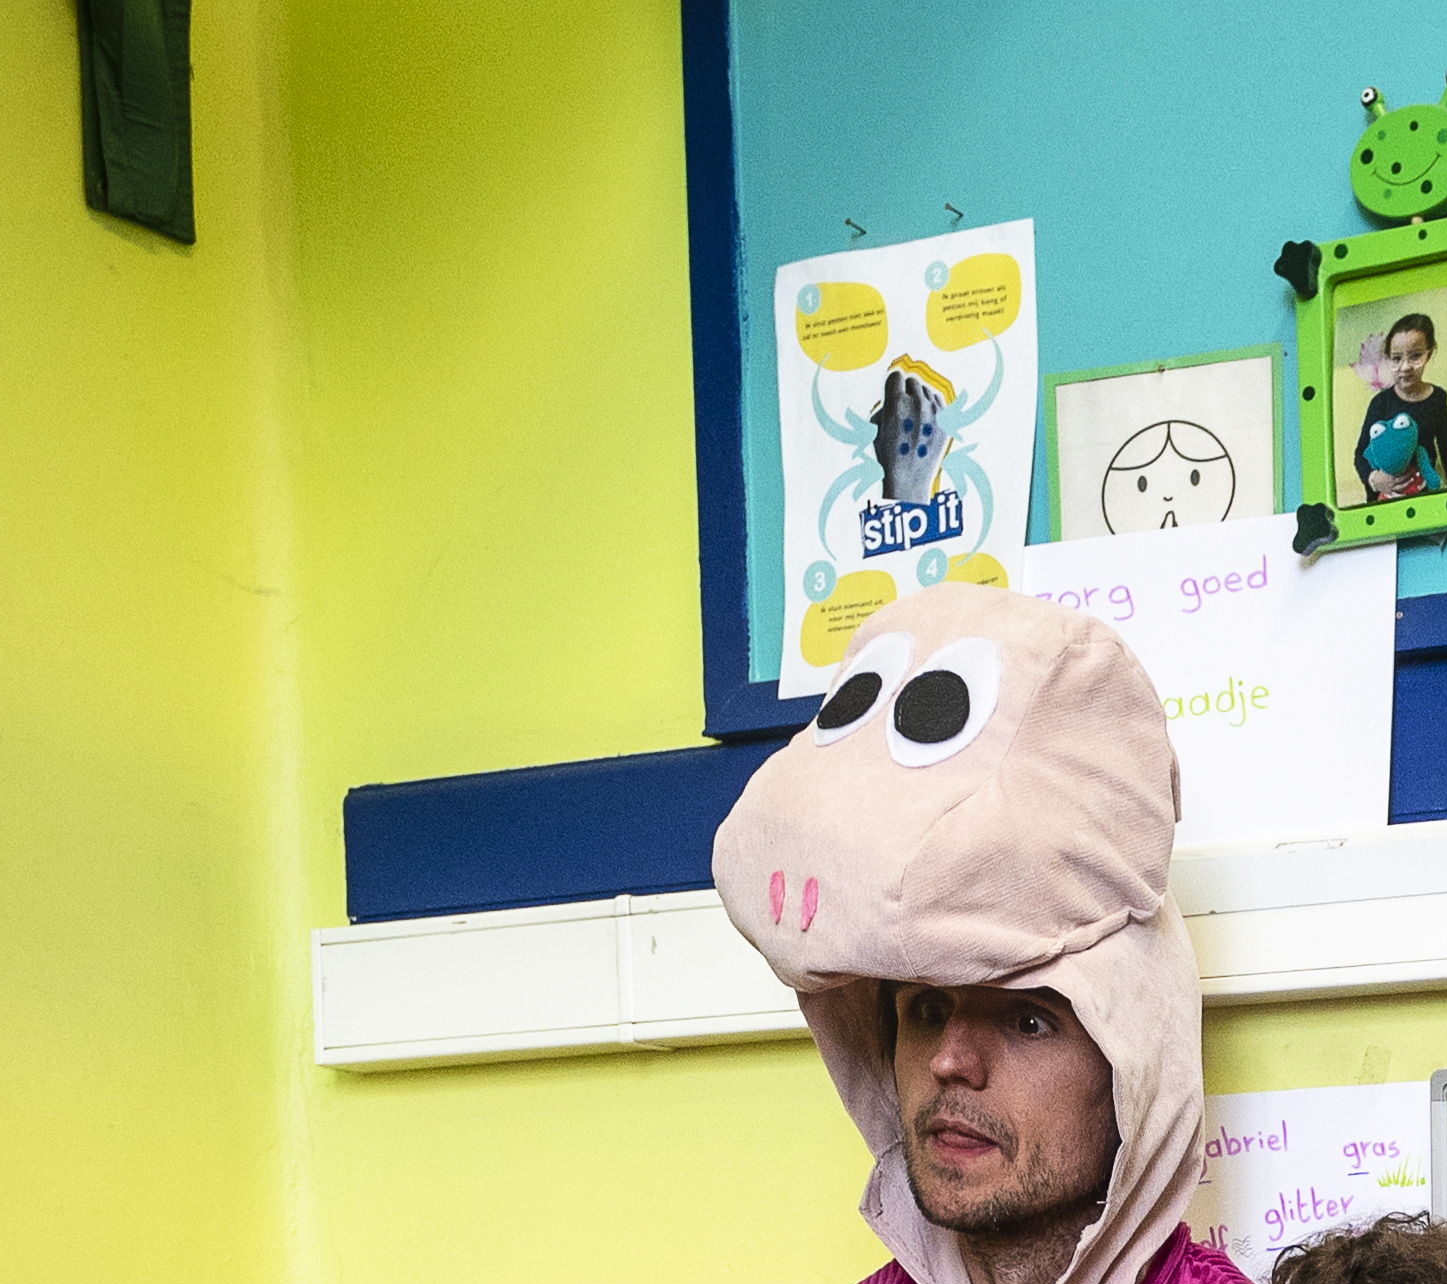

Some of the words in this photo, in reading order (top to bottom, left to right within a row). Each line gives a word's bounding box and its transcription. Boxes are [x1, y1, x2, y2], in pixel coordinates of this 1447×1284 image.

[931, 267, 942, 284] 2
[864, 504, 928, 551] stip
[937, 493, 961, 534] it
[812, 571, 826, 593] 3
[925, 557, 938, 578] 4
[1034, 584, 1136, 621] org
[1180, 553, 1270, 614] goed
[1162, 675, 1271, 728] aadje
[1204, 1118, 1289, 1159] abriel
[1342, 1139, 1401, 1170] gras
[1264, 1186, 1355, 1242] glitter
